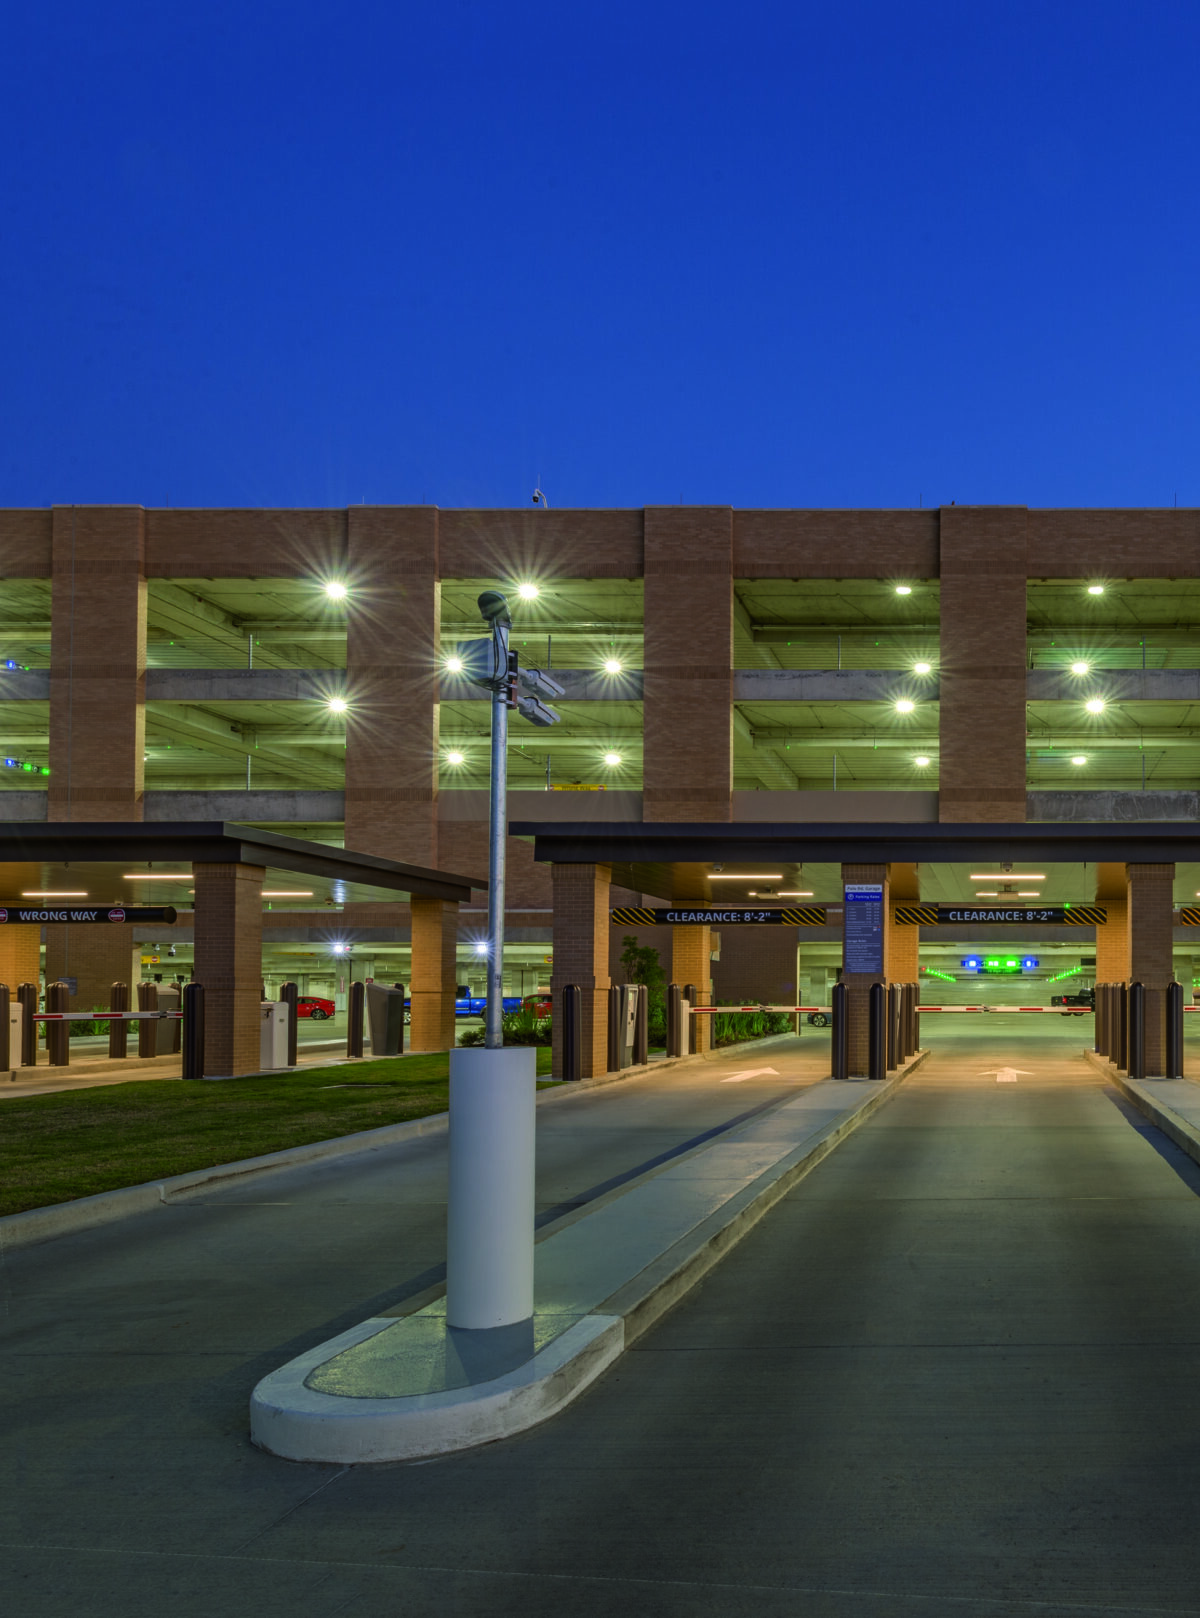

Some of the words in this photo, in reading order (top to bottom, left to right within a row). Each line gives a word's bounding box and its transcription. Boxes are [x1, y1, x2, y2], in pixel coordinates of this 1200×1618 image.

[19, 911, 67, 921] WRONG
[70, 911, 98, 921] WAY
[666, 912, 741, 922] CLEARANCE:
[744, 912, 771, 922] 8'-2"
[949, 911, 1023, 921] CLEARANCE:
[1026, 911, 1053, 921] 8'-2"
